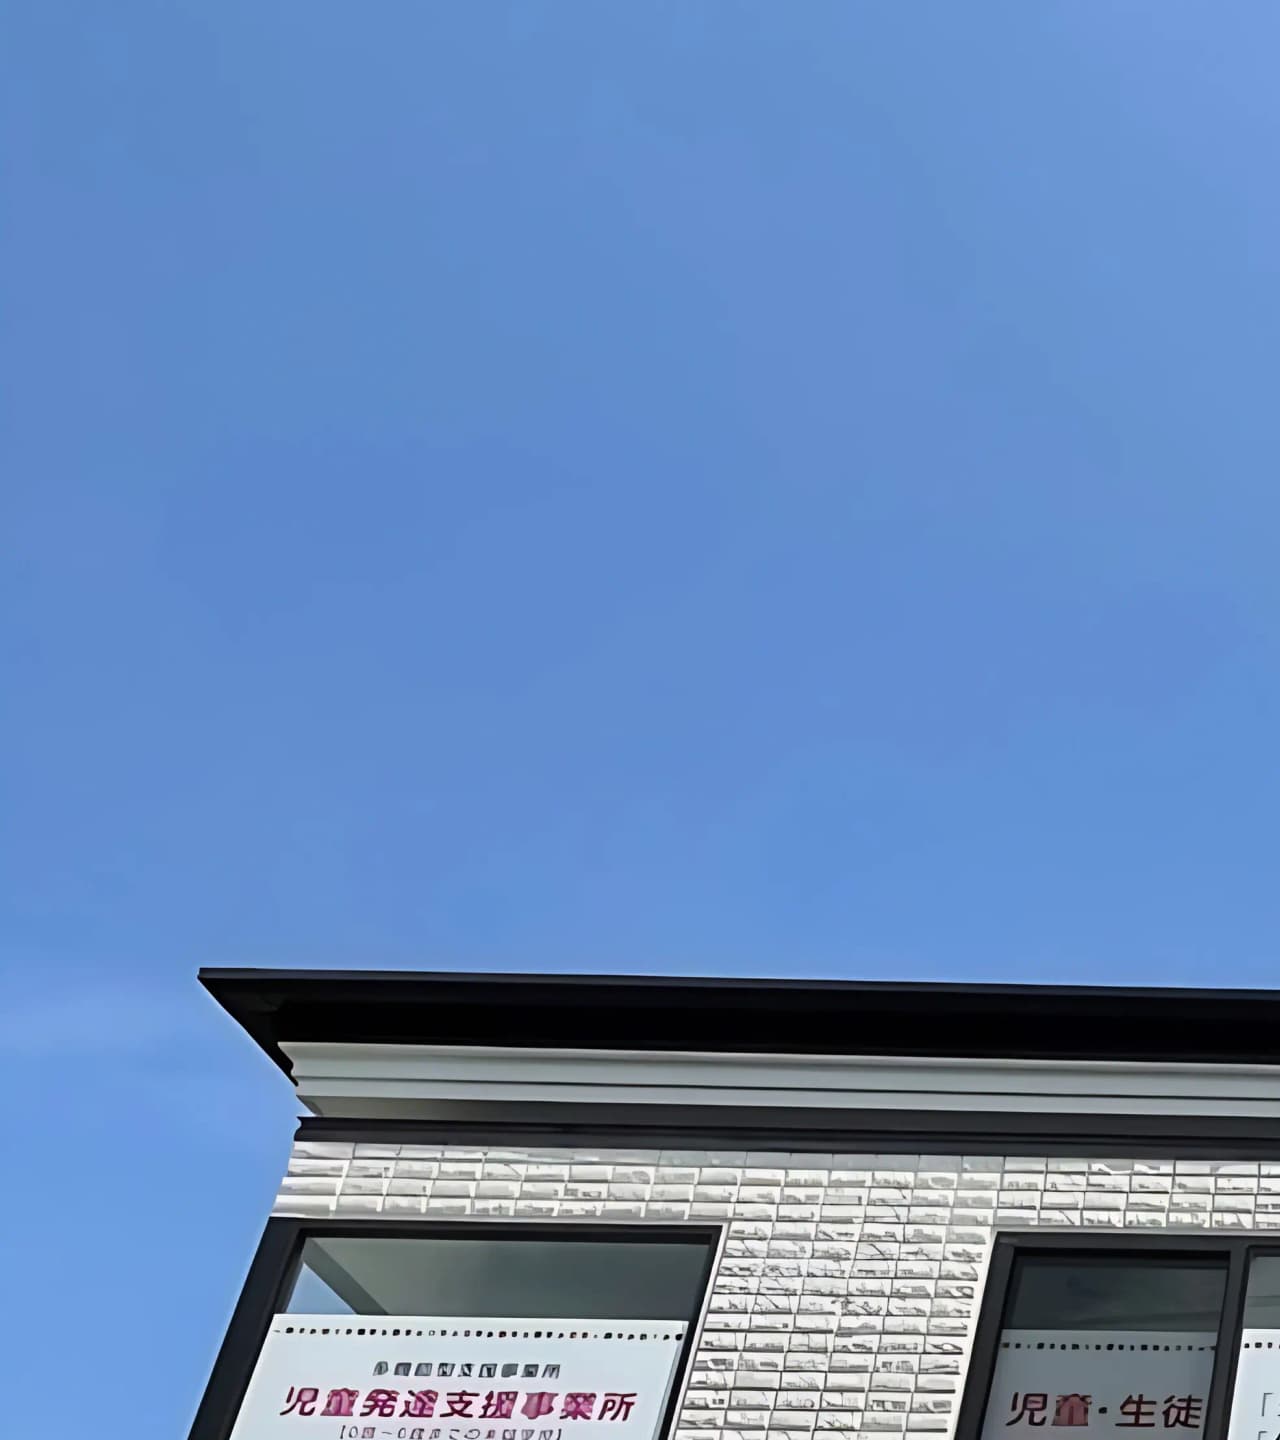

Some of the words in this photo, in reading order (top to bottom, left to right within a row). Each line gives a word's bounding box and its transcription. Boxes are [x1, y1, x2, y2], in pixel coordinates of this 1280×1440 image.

[1006, 1391, 1203, 1429] 児童・生徒
